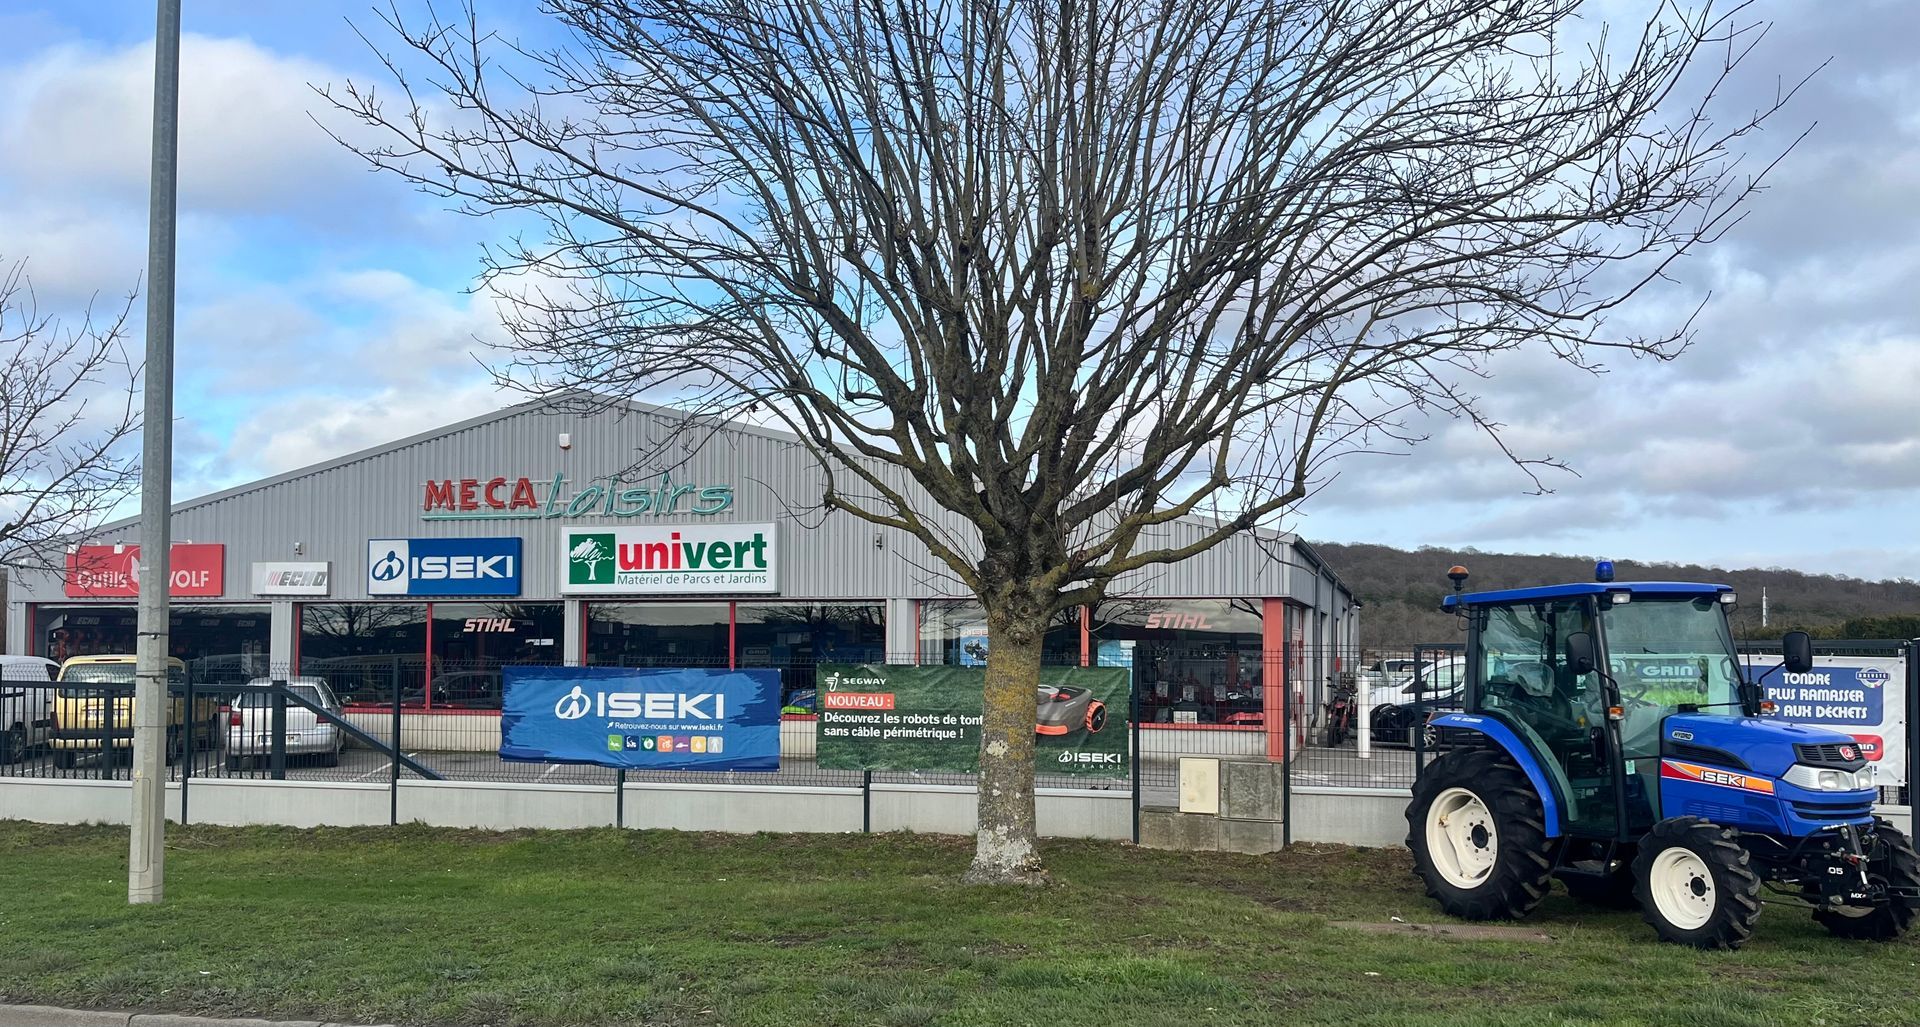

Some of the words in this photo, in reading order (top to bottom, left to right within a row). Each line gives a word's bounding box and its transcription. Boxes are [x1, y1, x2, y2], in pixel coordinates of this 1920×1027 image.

[424, 477, 537, 511] MECA
[544, 472, 733, 518] Loisirs
[619, 532, 767, 571] univert
[410, 555, 514, 579] ISEKI
[618, 573, 662, 585] Matériel
[666, 574, 680, 584] de
[683, 573, 711, 585] Parcs
[713, 574, 725, 584] et
[728, 573, 767, 585] Jardins
[463, 618, 516, 633] STIHL
[1145, 613, 1213, 630] STIHL
[1642, 665, 1694, 676] GRIN
[842, 677, 887, 686] SEGWAY
[1783, 672, 1831, 686] TONDRE
[827, 695, 884, 707] NOUVEAU
[1768, 687, 1796, 700] PLUS
[1800, 688, 1865, 703] RAMASSER
[597, 692, 724, 719] ISEKI
[1784, 704, 1812, 718] AUX
[1816, 704, 1868, 719] DÉCHETS
[824, 712, 880, 724] Découvrez
[883, 713, 900, 724] les
[903, 713, 940, 725] robots
[943, 714, 957, 725] de
[614, 722, 668, 731] Retrouvez-nous
[669, 723, 680, 731] sur
[681, 723, 723, 731] www.iseki.fr
[824, 727, 849, 737] sans
[851, 726, 880, 738] câble
[883, 727, 957, 741] périmétrique
[1074, 752, 1121, 763] ISEKI
[1700, 769, 1746, 788] ISEKI
